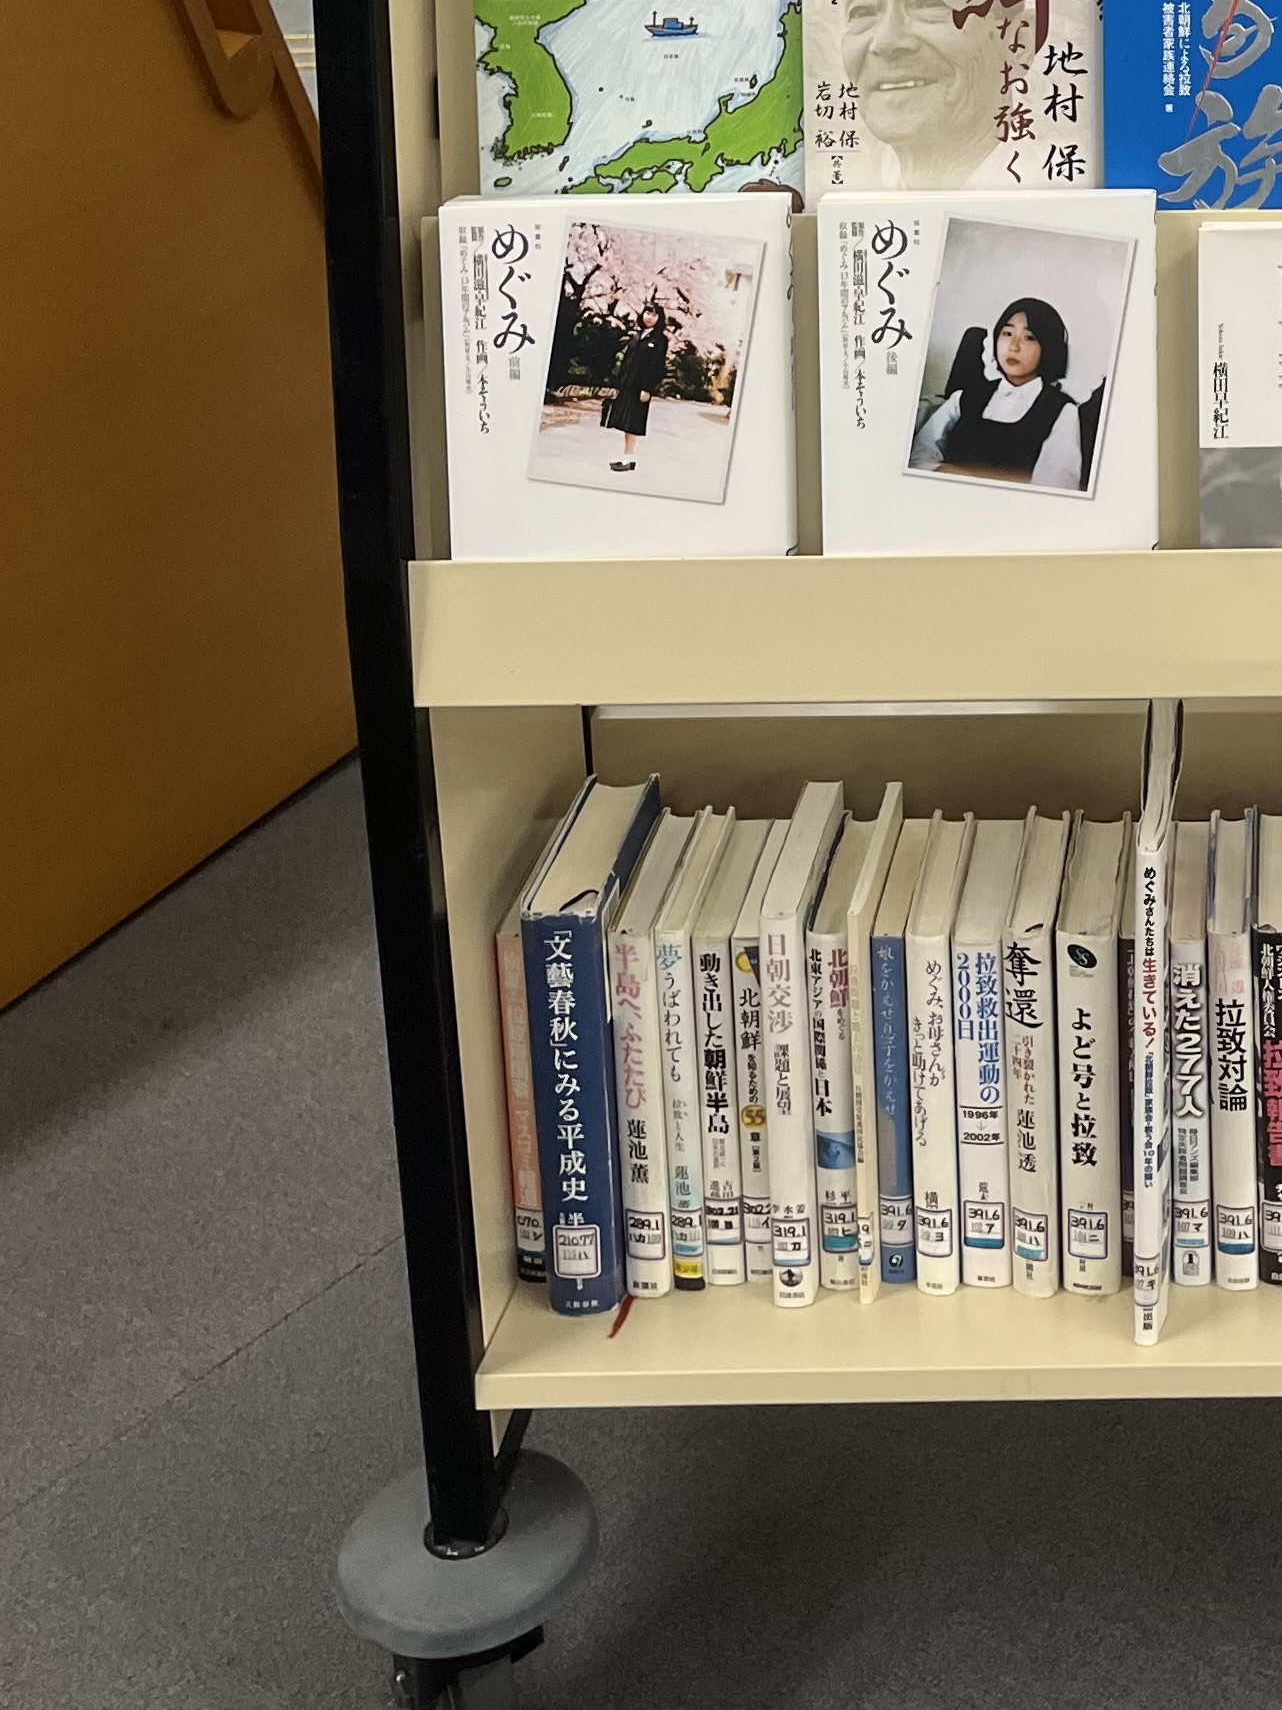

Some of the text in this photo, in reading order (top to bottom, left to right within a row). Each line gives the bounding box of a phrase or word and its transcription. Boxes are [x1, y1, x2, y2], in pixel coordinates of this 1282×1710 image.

[1162, 2, 1175, 96] 被害者家族連絡会
[1178, 2, 1191, 97] 北朝鮮による拉致
[813, 82, 836, 149] 岩切 裕
[839, 83, 860, 149] 地村 保
[993, 17, 1036, 183] なお強く
[1042, 41, 1088, 182] 地村 保
[491, 223, 535, 355] めぐみ
[871, 219, 913, 350] めぐみ
[1213, 362, 1229, 439] 横田早紀江
[614, 943, 646, 1109] 半島へ、ふたたび
[657, 944, 682, 1082] 夢うばわれても
[766, 934, 793, 1034] 日朝交渉
[877, 944, 897, 1116] 娘をかえせ息子をかえせ
[956, 953, 974, 1040] 2000日
[975, 952, 1000, 1104] 拉致救出運動の
[1004, 941, 1044, 1029] 奪還
[1261, 943, 1276, 1038] 北朝鮮人権委員会
[544, 930, 588, 1202] 「文藝春秋」にみる平成史
[700, 952, 730, 1134] 動き出した朝鮮半島
[774, 1043, 791, 1116] 課題と展望
[1022, 1035, 1035, 1106] 引き裂かれた
[1071, 1008, 1098, 1167] よど号と拉致
[1172, 963, 1203, 1117] 消えた277人
[1215, 998, 1248, 1112] 拉致対論
[627, 1119, 649, 1184] 蓮池薫
[963, 1110, 998, 1119] 1996年
[964, 1132, 1000, 1141] 2002年
[1017, 1109, 1037, 1173] 蓮池透
